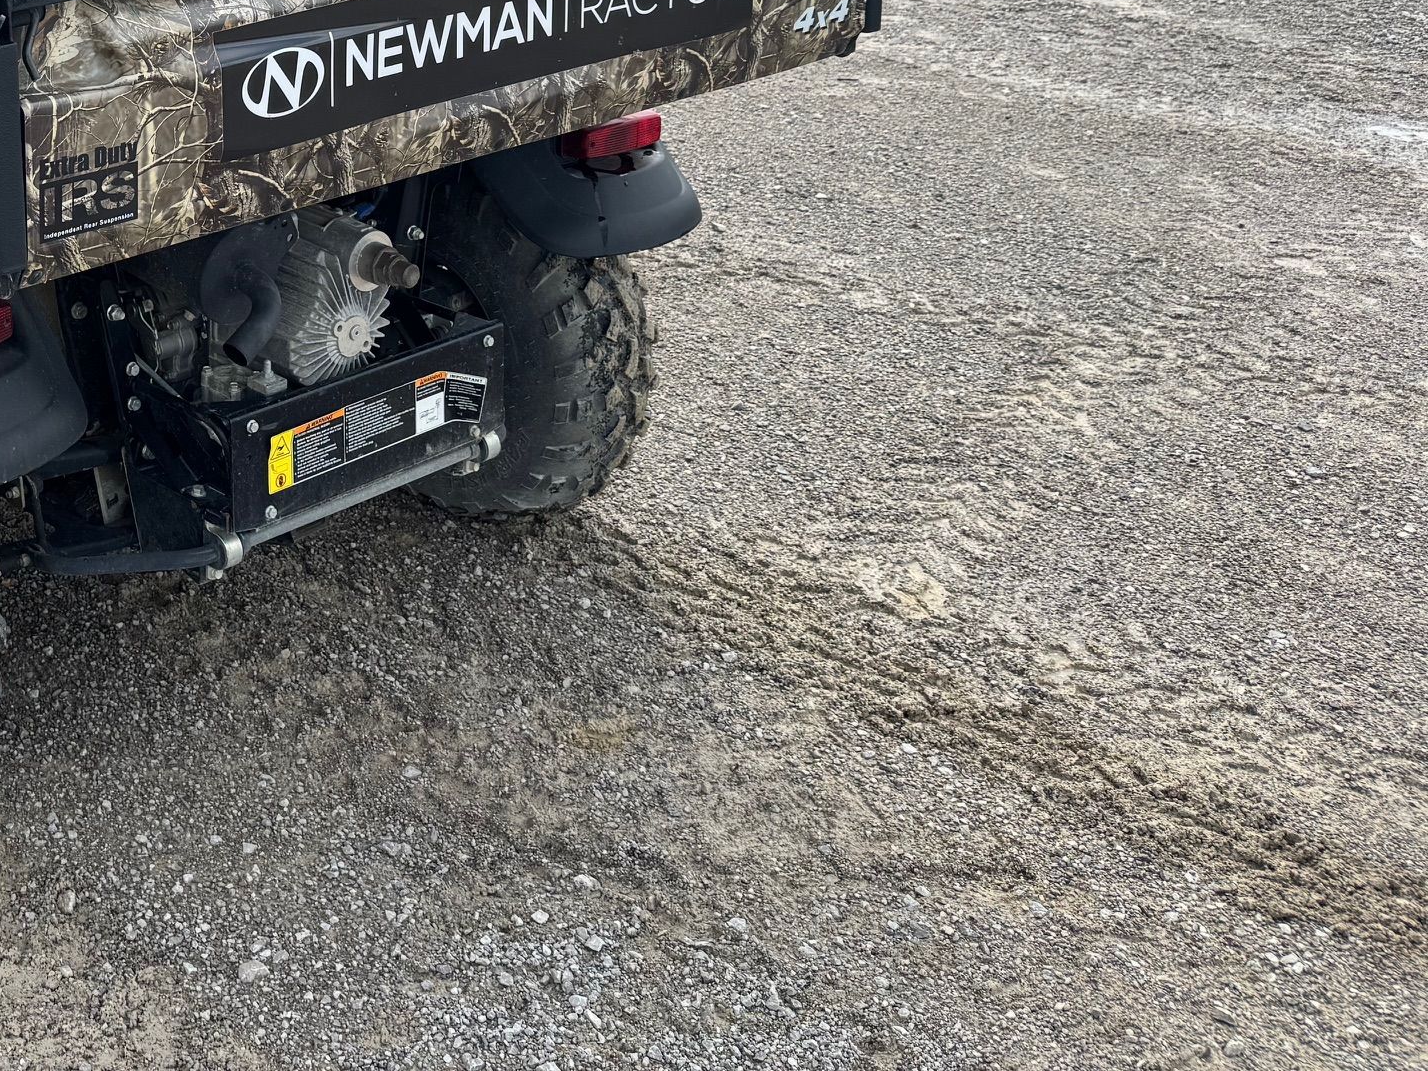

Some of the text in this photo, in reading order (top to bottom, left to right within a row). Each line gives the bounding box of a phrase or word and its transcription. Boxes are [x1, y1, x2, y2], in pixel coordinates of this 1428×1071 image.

[40, 142, 138, 179] Extra Duty
[44, 171, 135, 227] IRS
[44, 212, 134, 240] Independent Rear Suspension
